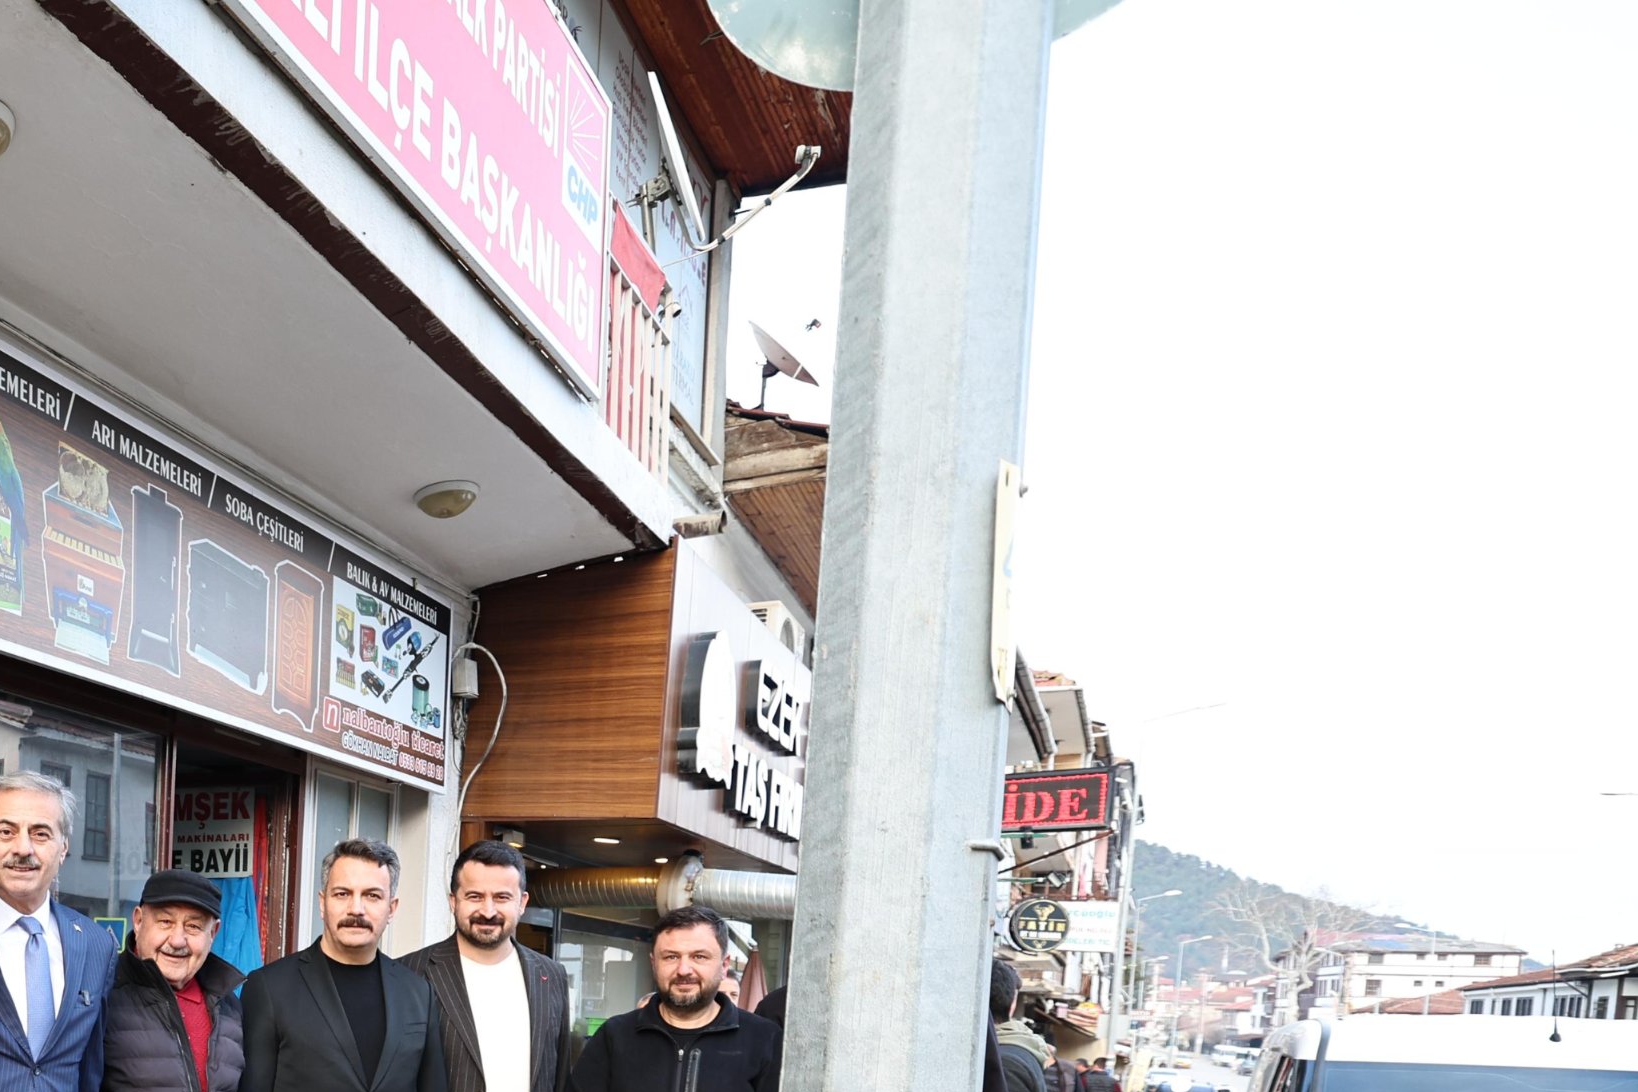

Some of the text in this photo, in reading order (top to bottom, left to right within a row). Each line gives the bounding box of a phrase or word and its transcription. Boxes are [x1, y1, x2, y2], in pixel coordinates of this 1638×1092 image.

[493, 19, 560, 159] PARTİSİ
[441, 97, 595, 353] BAŞKANLIĞI
[567, 165, 599, 226] CHP
[91, 420, 202, 497] ARI MALZEMELERİ
[225, 493, 304, 553] SOBA ÇEŞİTLERİ
[346, 562, 438, 626] BALIK & AV MALZEMELERİ
[342, 707, 410, 750] nalbantoğlu
[411, 731, 445, 760] ticaret
[177, 833, 250, 844] MAKİNALARI
[190, 843, 248, 873] BAYİİ
